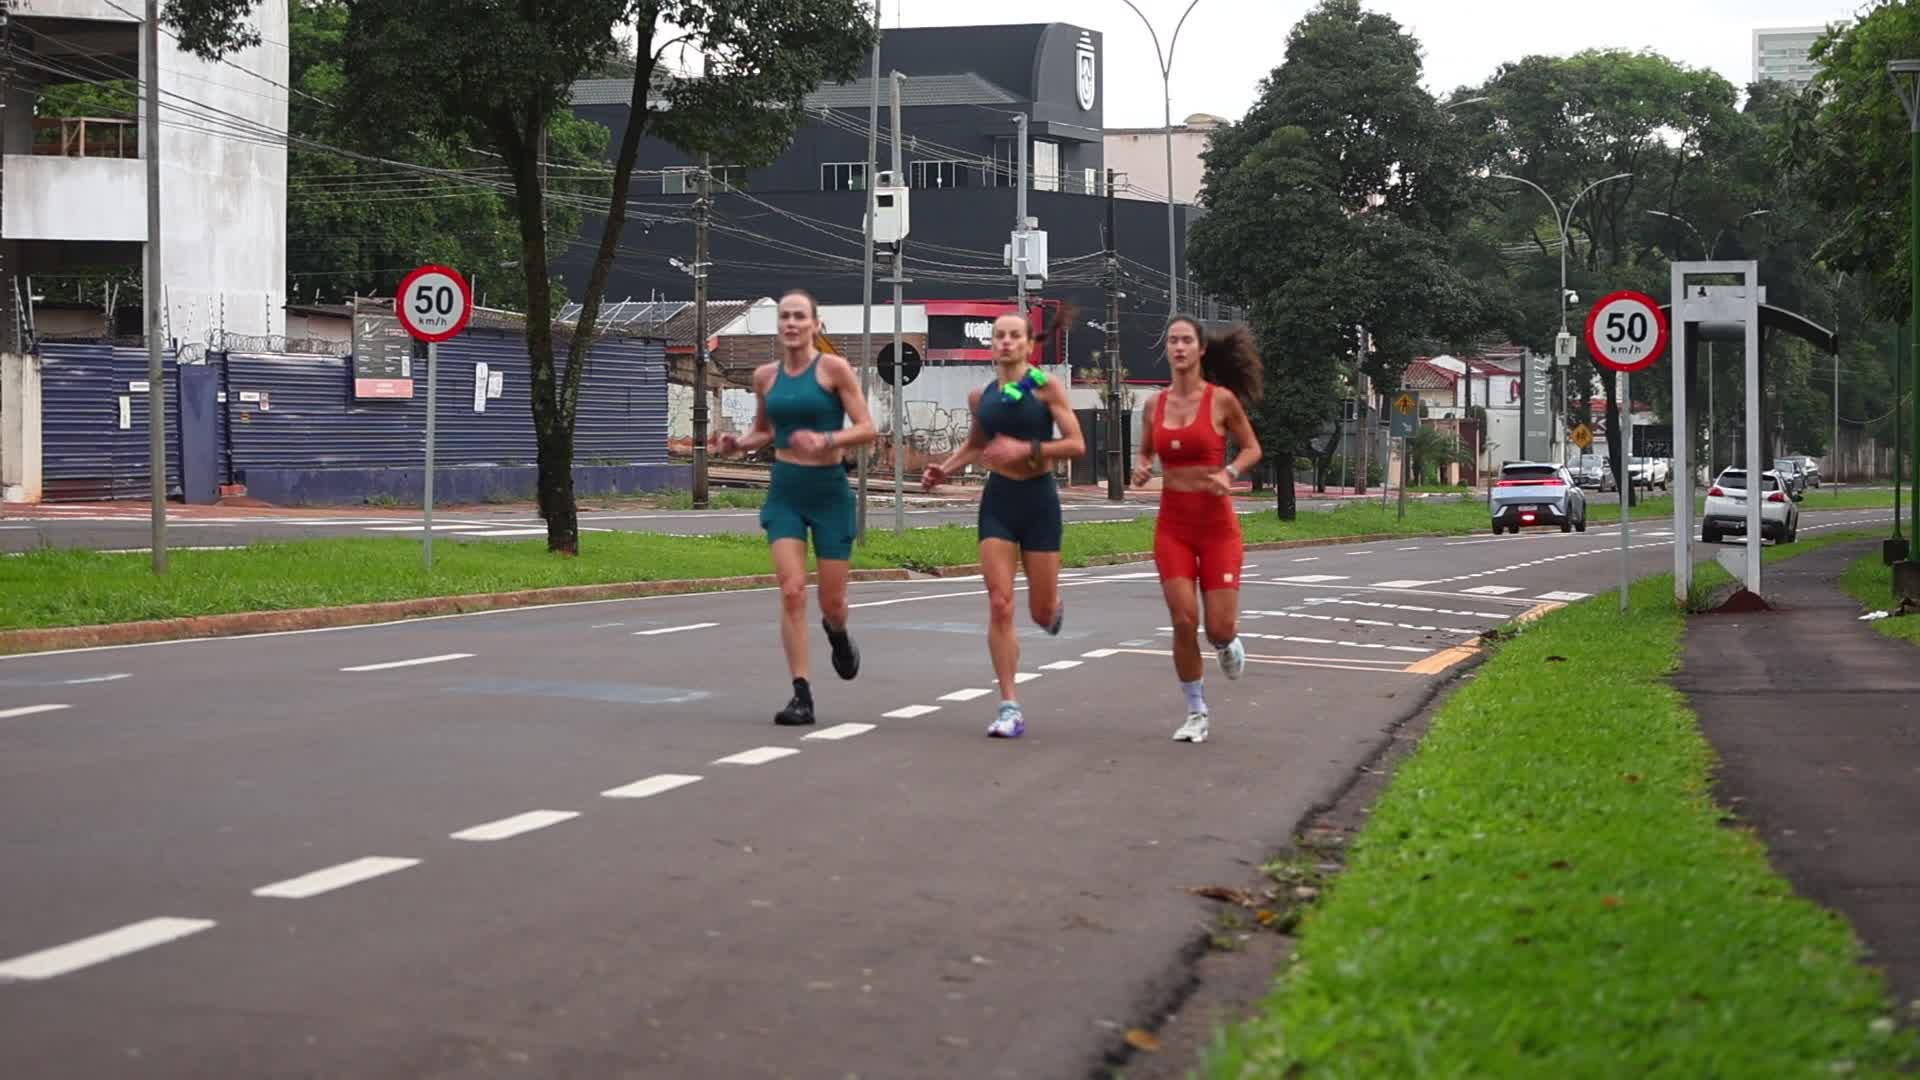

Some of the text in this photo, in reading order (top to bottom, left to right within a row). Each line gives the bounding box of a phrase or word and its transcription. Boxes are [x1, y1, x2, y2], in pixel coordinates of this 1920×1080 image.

[415, 286, 454, 315] 50
[419, 317, 447, 326] km/h
[1606, 312, 1648, 343] 50
[1610, 345, 1641, 354] km/h
